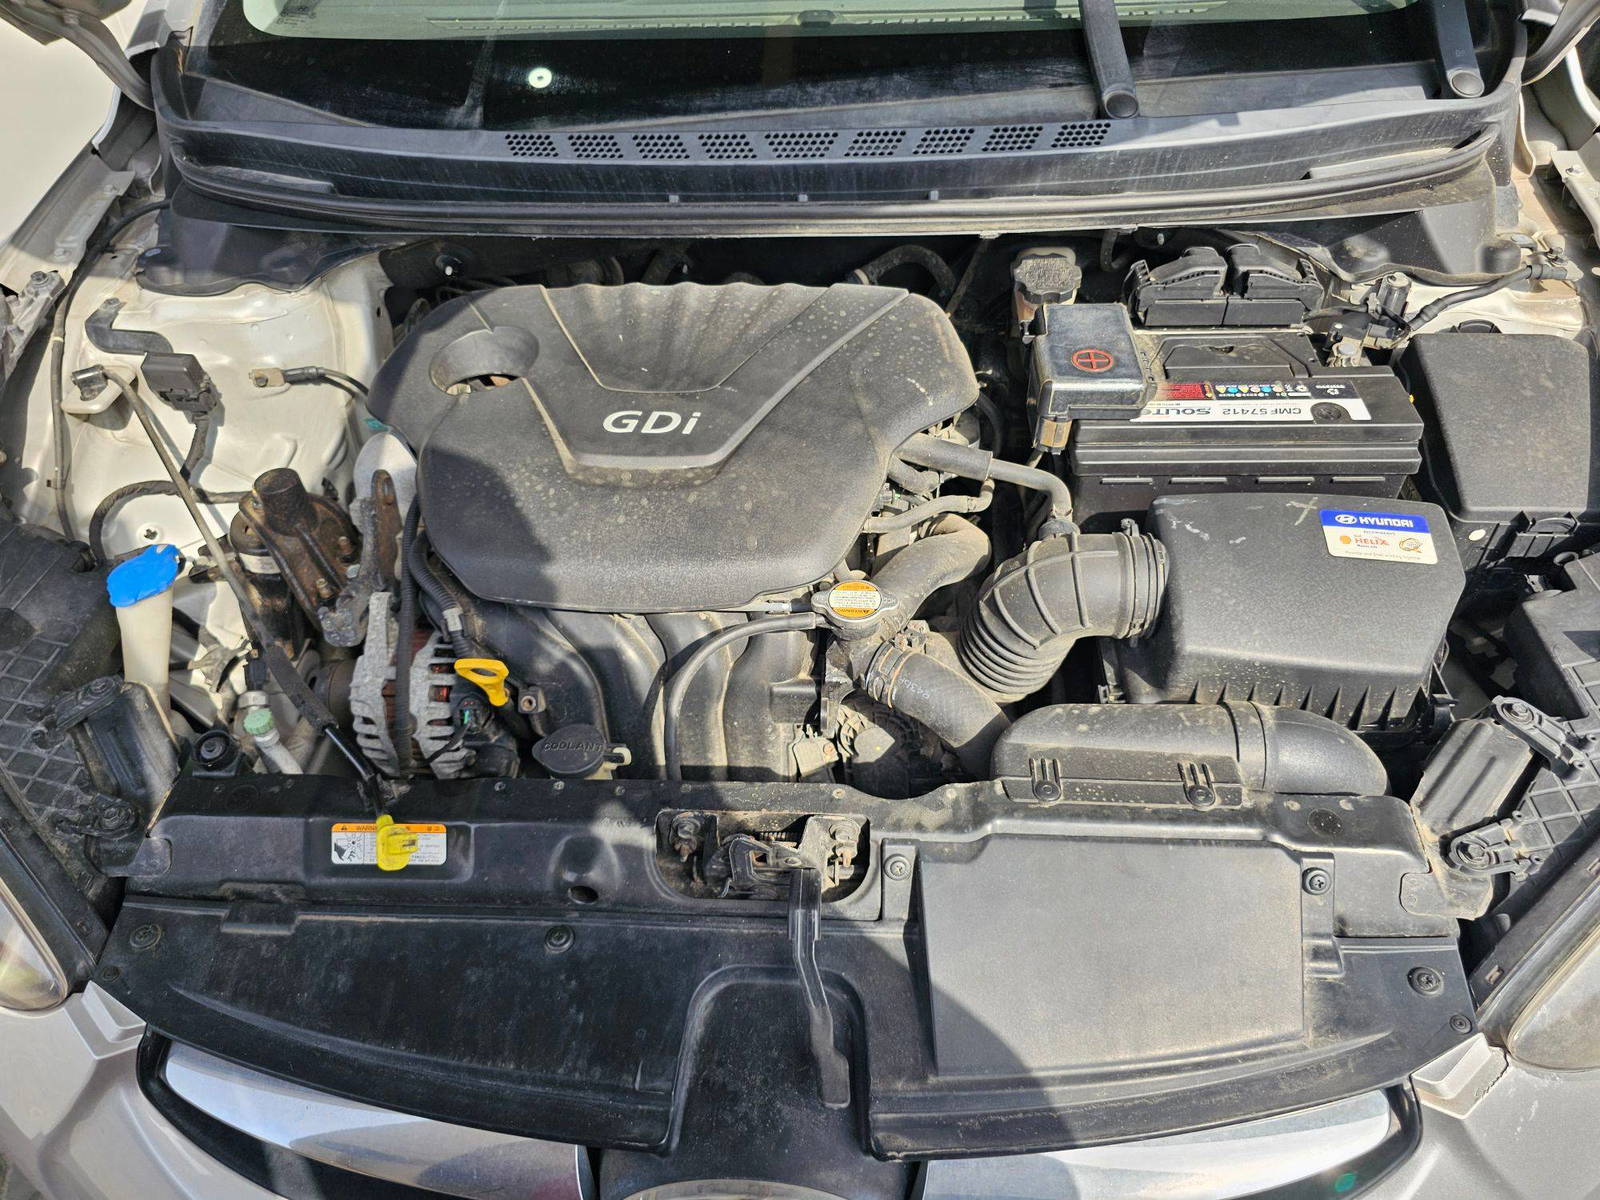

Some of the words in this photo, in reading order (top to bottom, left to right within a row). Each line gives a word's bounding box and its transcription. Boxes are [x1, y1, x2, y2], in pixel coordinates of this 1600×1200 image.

[1222, 407, 1268, 415] 57412
[1271, 407, 1302, 415] CMF
[602, 410, 701, 434] GDi
[1358, 516, 1414, 528] HYUNDAI
[1354, 537, 1390, 546] HELIX
[543, 742, 602, 753] COOLANT
